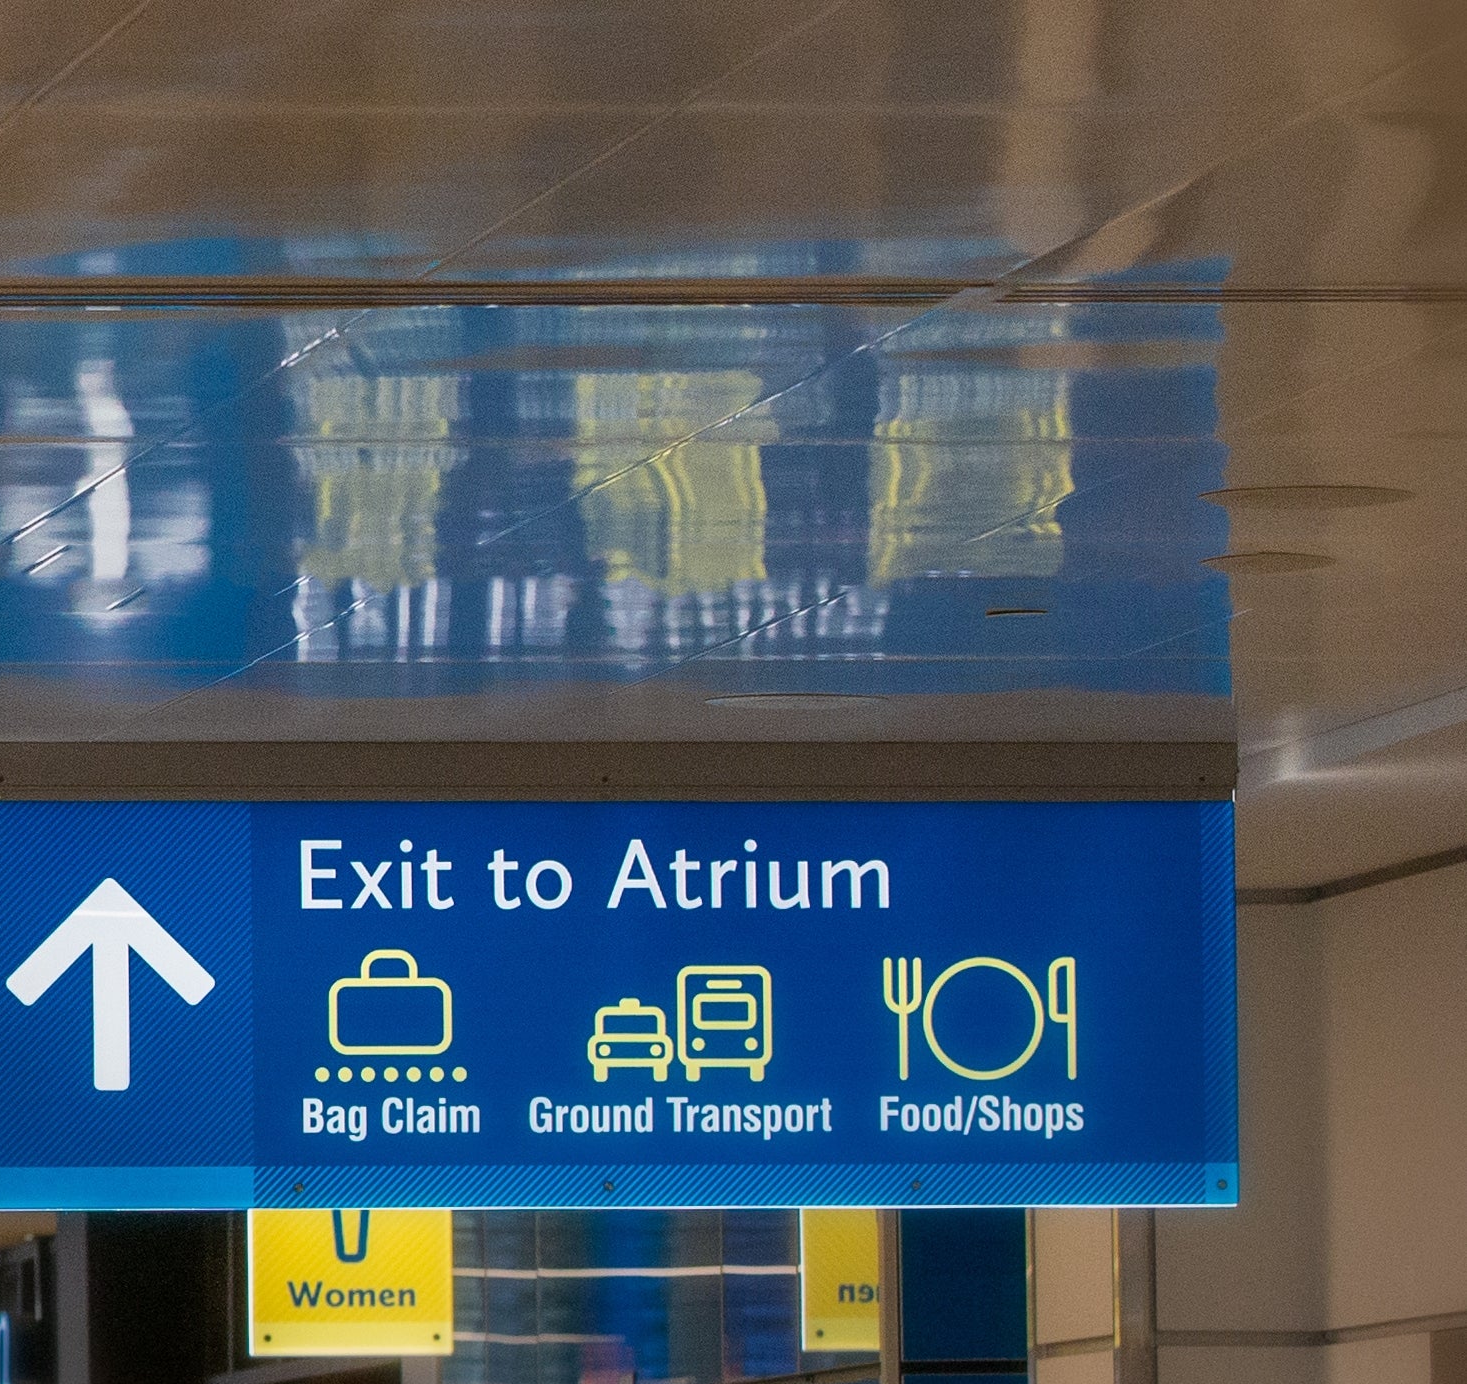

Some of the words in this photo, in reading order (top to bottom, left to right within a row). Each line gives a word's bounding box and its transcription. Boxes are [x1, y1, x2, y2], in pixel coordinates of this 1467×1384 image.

[300, 839, 454, 910] Exit
[488, 848, 573, 910] to
[608, 838, 890, 910] Atrium
[302, 1097, 368, 1142] Bag
[382, 1096, 480, 1135] Claim
[529, 1096, 654, 1134] Ground
[666, 1096, 833, 1141] Transport
[880, 1094, 1084, 1139] Food/Shops
[287, 1281, 416, 1308] Women
